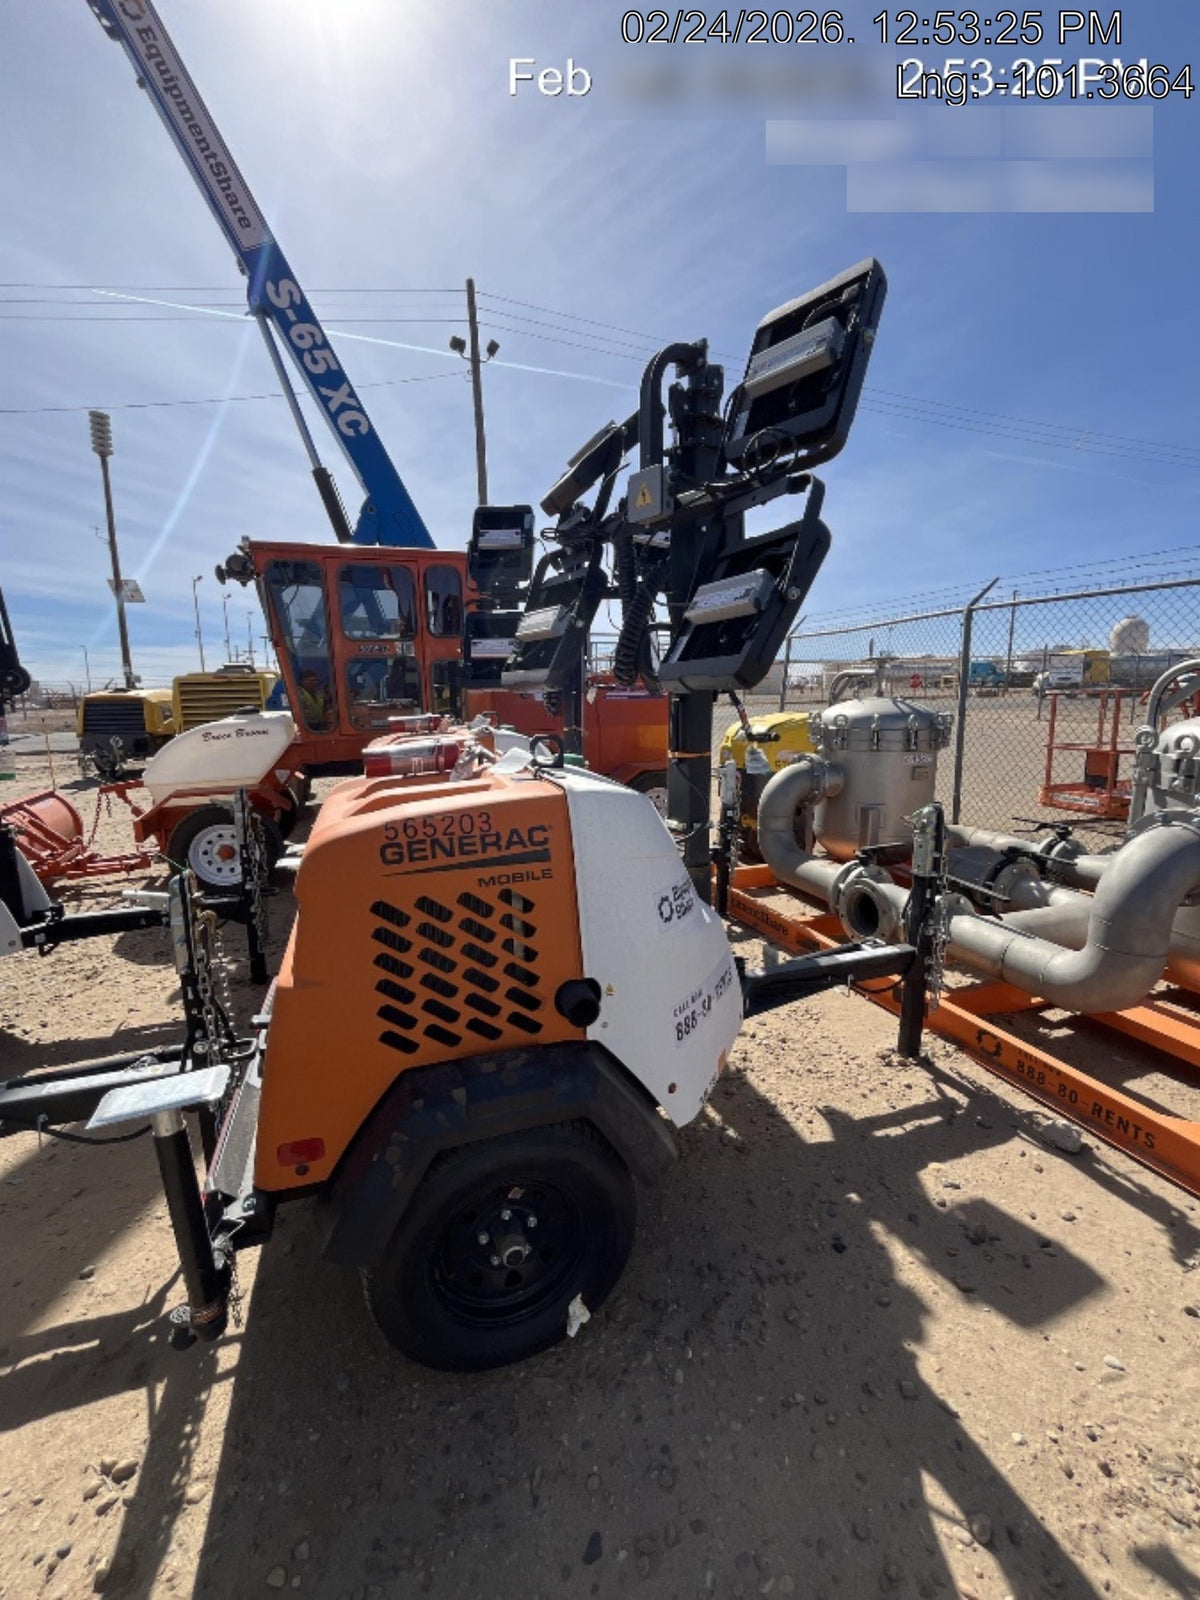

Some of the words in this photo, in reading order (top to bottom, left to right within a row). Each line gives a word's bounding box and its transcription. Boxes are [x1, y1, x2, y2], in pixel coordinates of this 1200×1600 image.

[136, 25, 252, 231] EquipmentShare
[266, 278, 339, 375] S-65
[317, 382, 370, 437] XC
[380, 824, 551, 866] GENERAC
[384, 811, 493, 842] 565203
[478, 868, 554, 888] MOBILE
[1016, 1059, 1157, 1149] 888-80-RENTS
